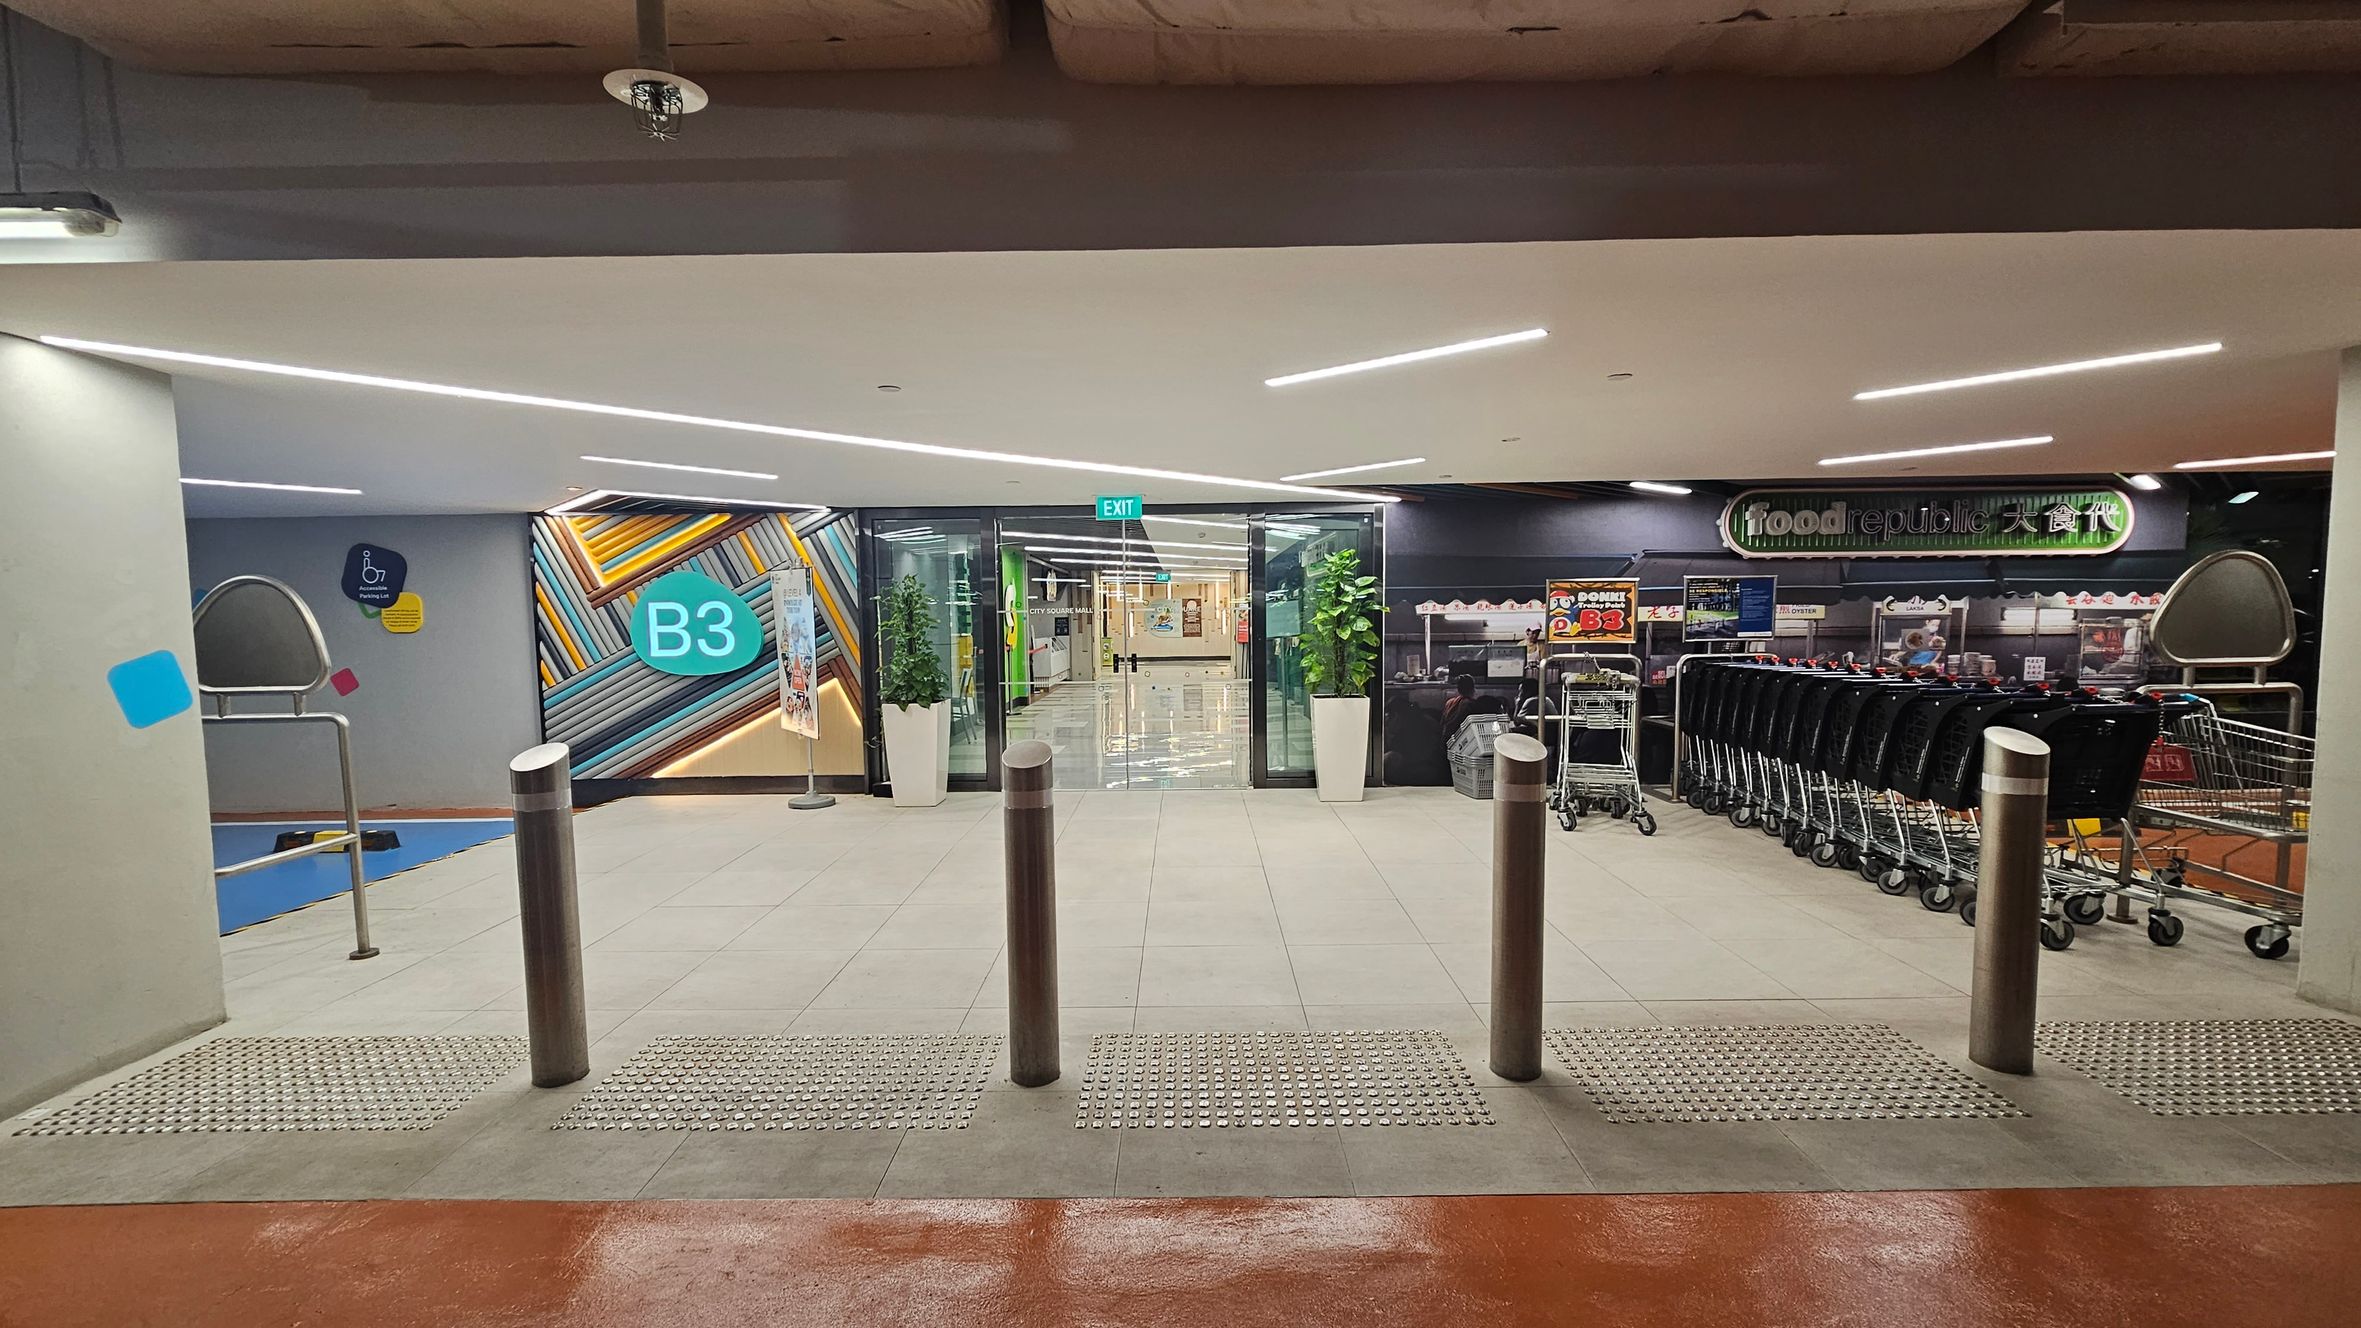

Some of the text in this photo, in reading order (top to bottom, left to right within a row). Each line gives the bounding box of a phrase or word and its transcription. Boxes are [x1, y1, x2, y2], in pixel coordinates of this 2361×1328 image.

[1103, 499, 1134, 516] EXIT
[2002, 501, 2122, 534] 大食代
[1578, 591, 1626, 602] DONKI
[1046, 607, 1074, 615] SQUARE
[1578, 602, 1604, 610] Trolley
[1580, 609, 1624, 631] B3
[648, 601, 735, 657] B3
